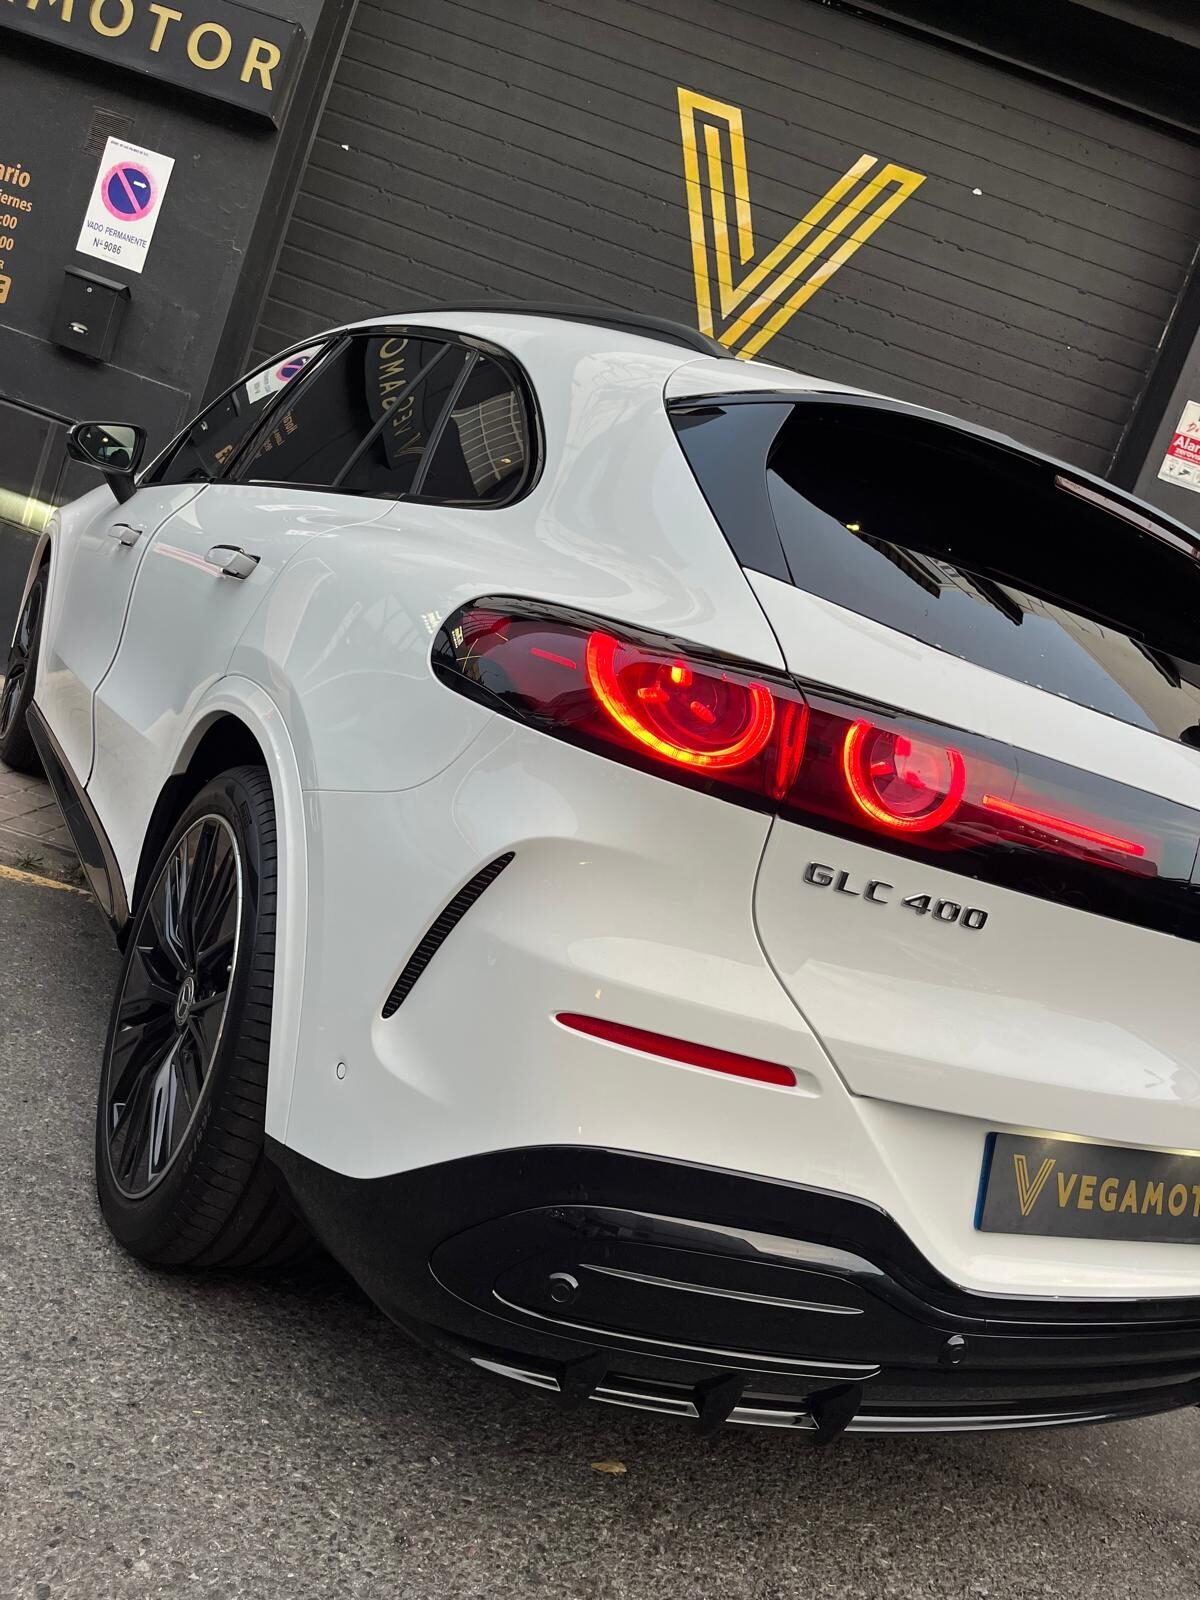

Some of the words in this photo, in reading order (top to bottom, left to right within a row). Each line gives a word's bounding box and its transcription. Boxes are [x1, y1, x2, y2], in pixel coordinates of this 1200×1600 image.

[86, 219, 104, 233] VADO
[104, 226, 148, 249] PERMANENTE
[803, 861, 895, 905] GLC
[901, 893, 989, 930] 400
